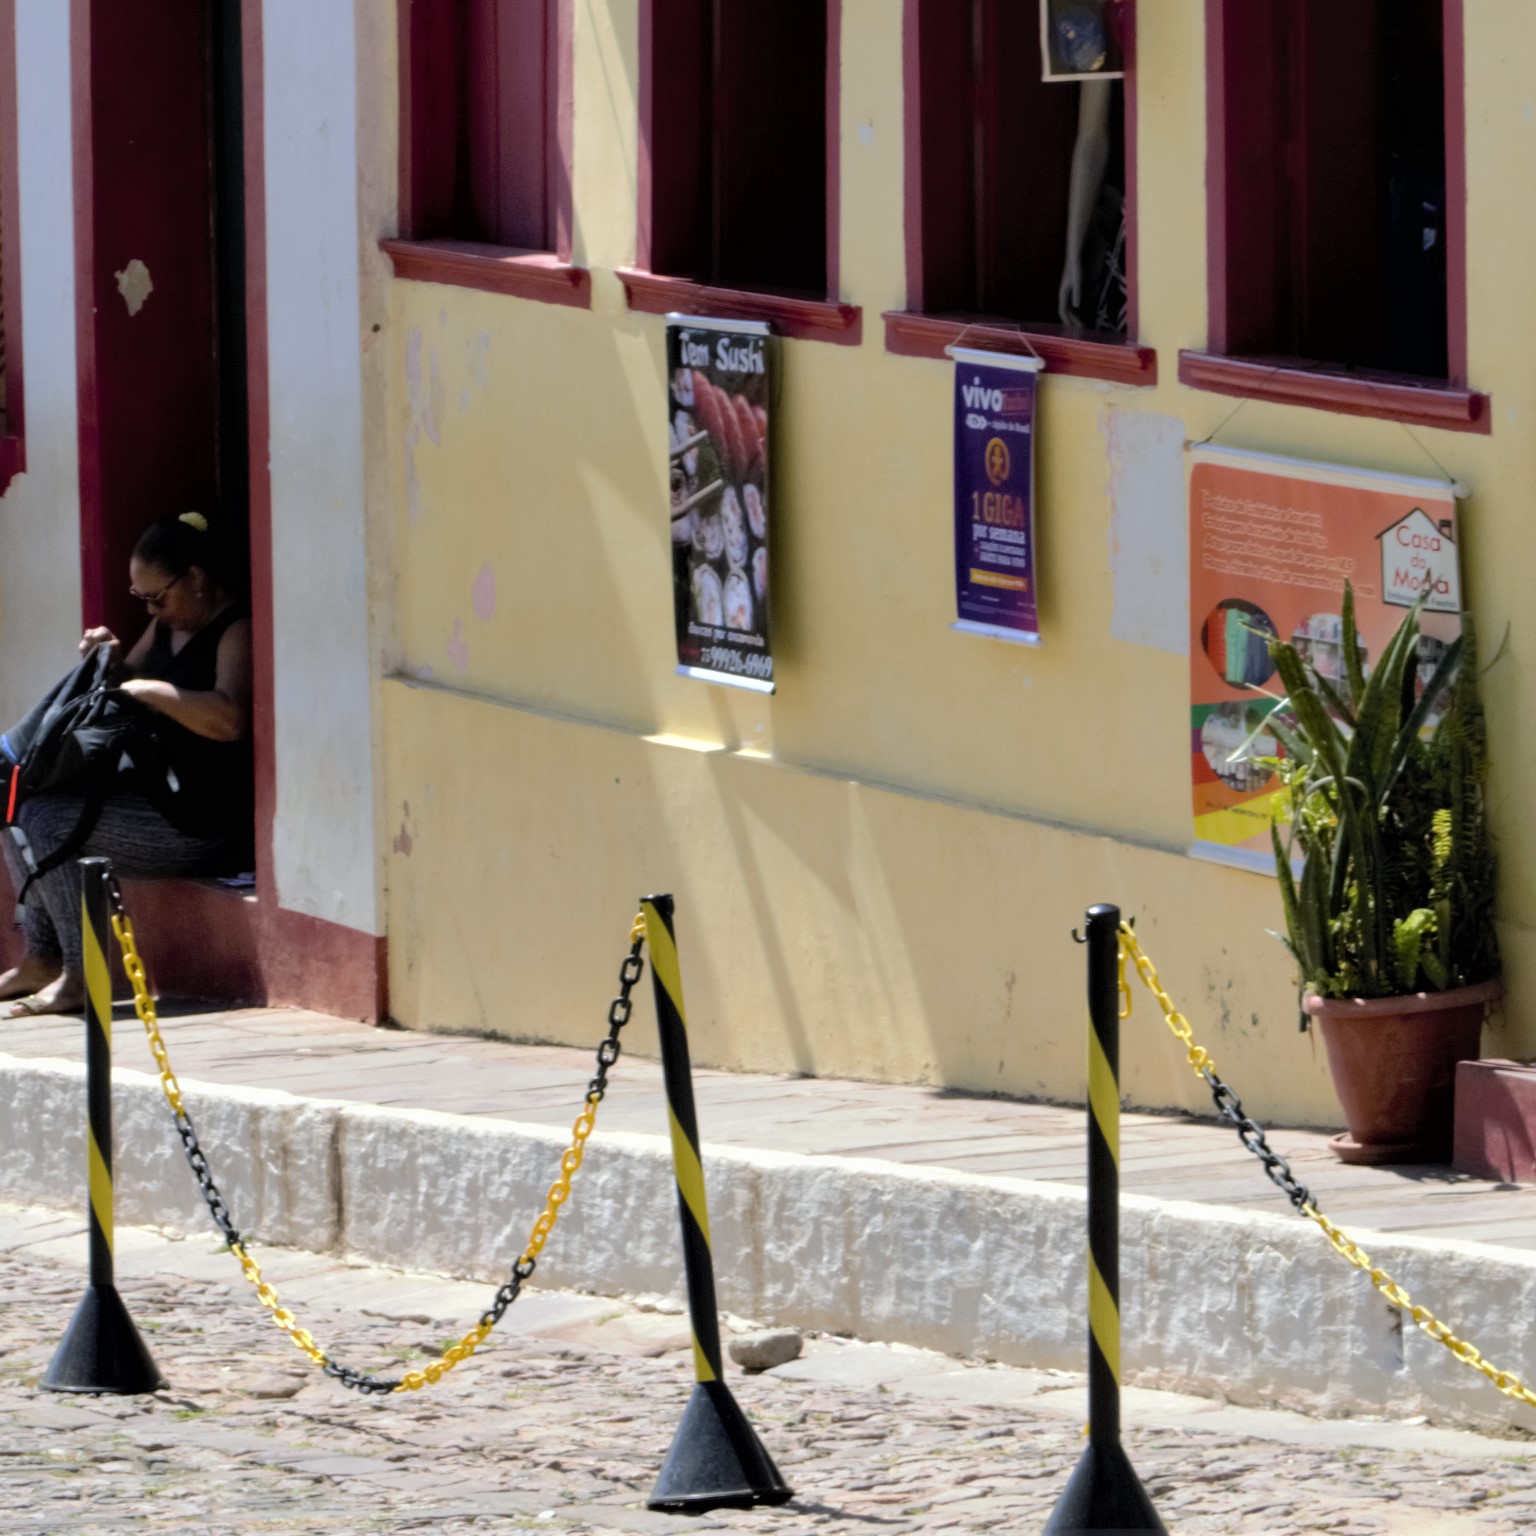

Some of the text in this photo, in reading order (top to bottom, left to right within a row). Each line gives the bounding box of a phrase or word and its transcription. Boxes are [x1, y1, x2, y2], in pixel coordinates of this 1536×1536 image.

[678, 331, 765, 375] Tem Sushi
[961, 375, 1004, 413] vivo
[972, 491, 1026, 530] 1 GIGA
[1396, 525, 1441, 552] Casa
